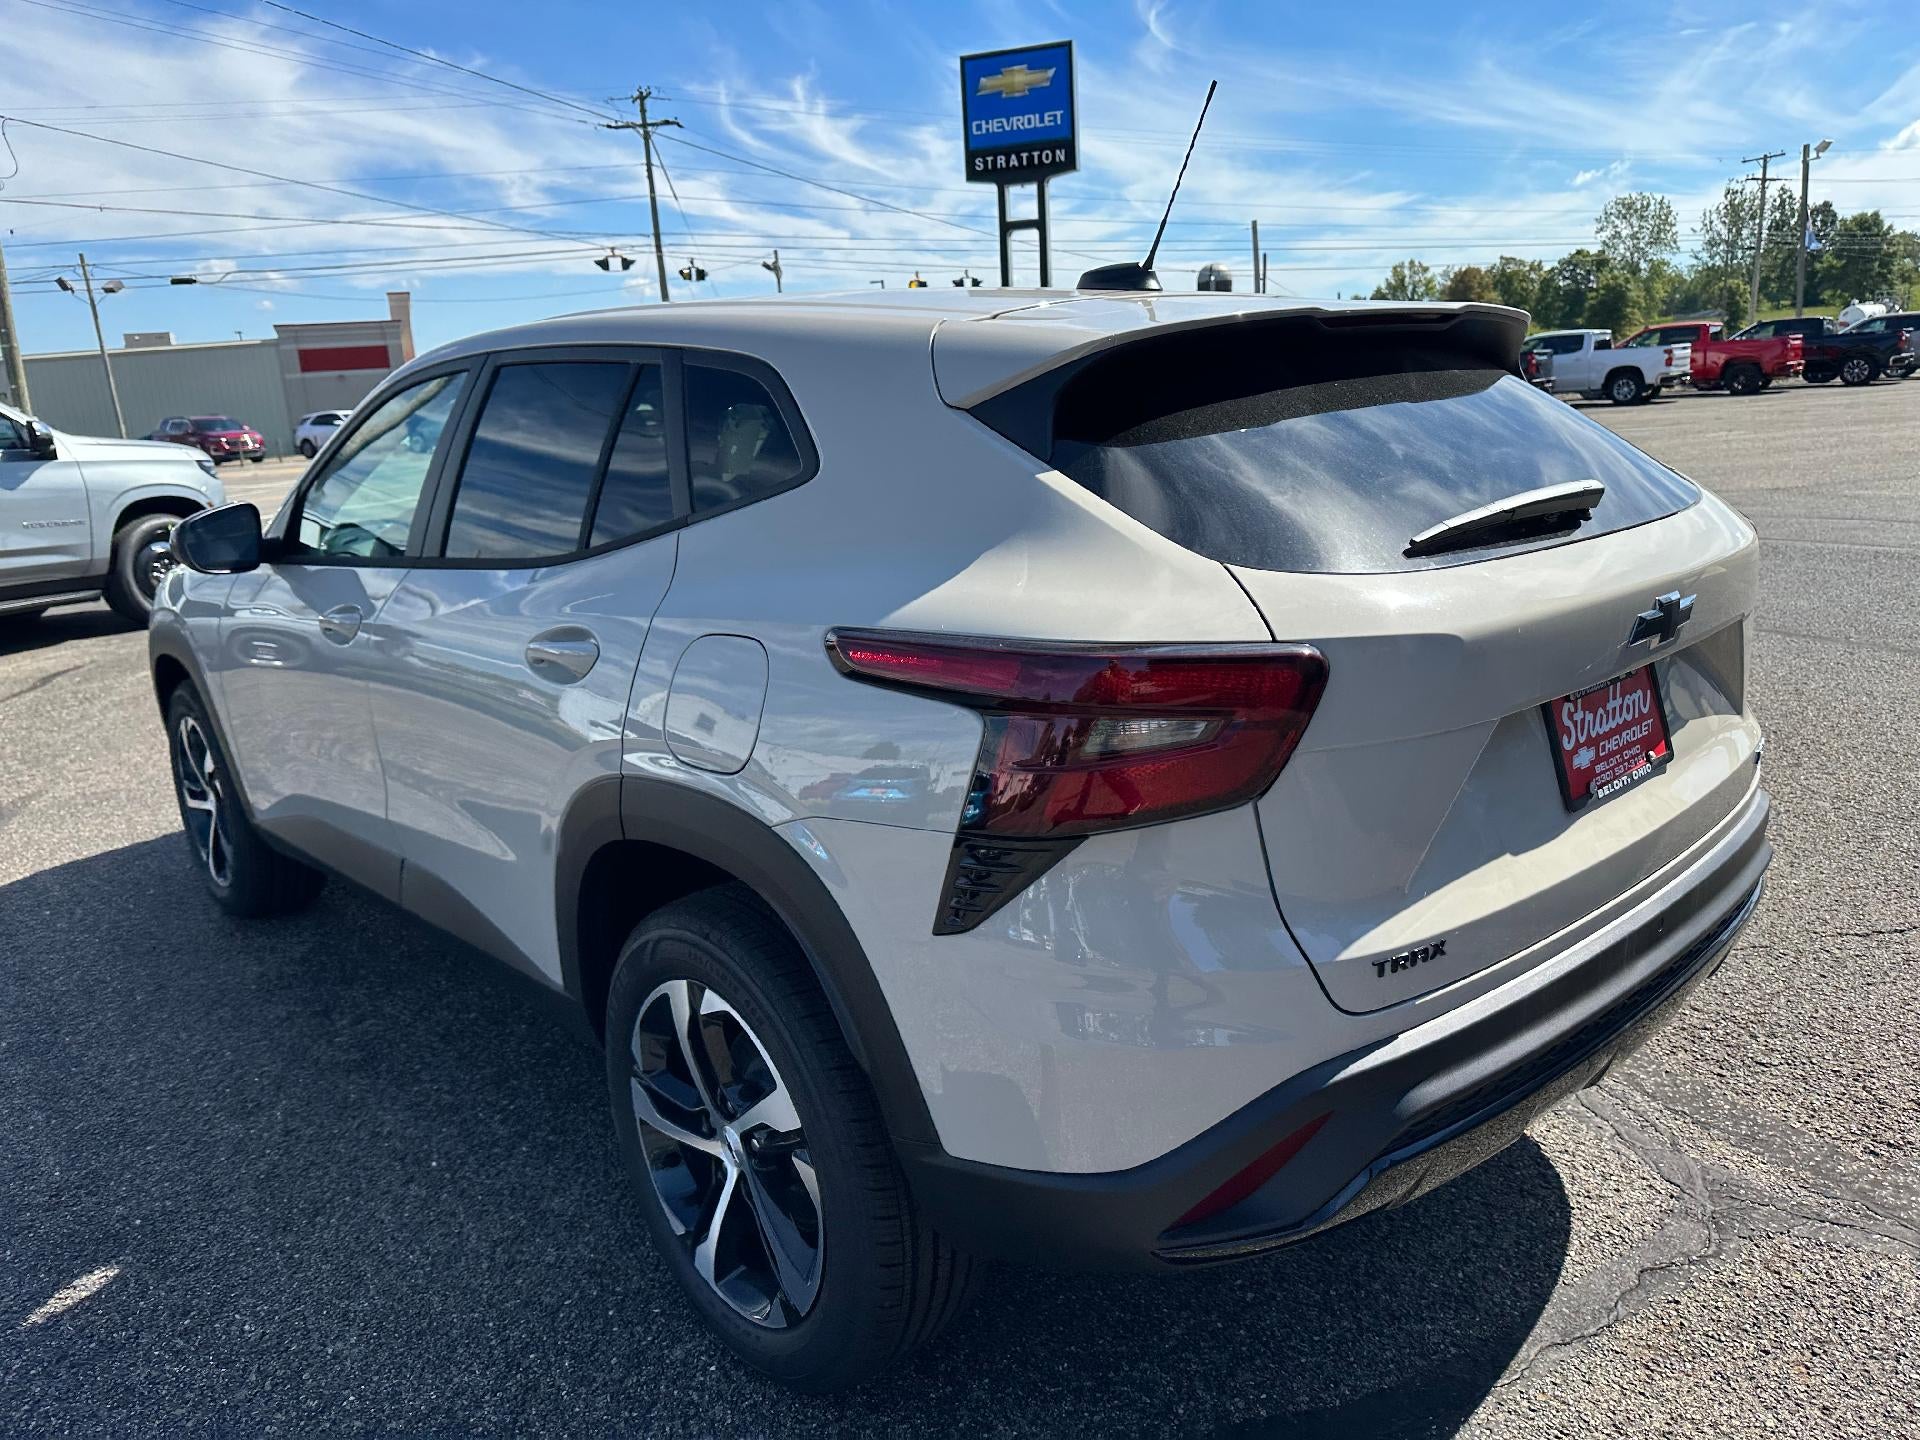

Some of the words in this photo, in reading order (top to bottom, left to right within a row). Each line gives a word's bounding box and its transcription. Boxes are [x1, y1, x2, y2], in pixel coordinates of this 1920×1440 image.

[971, 110, 1064, 135] CHEVROLET
[974, 149, 1066, 171] STRATTON
[1561, 682, 1651, 751] Stratton
[1599, 719, 1654, 757] CHEVROLET
[1624, 745, 1641, 762] OHIO
[1632, 763, 1652, 781] OHIO
[1372, 938, 1447, 978] TRAX
